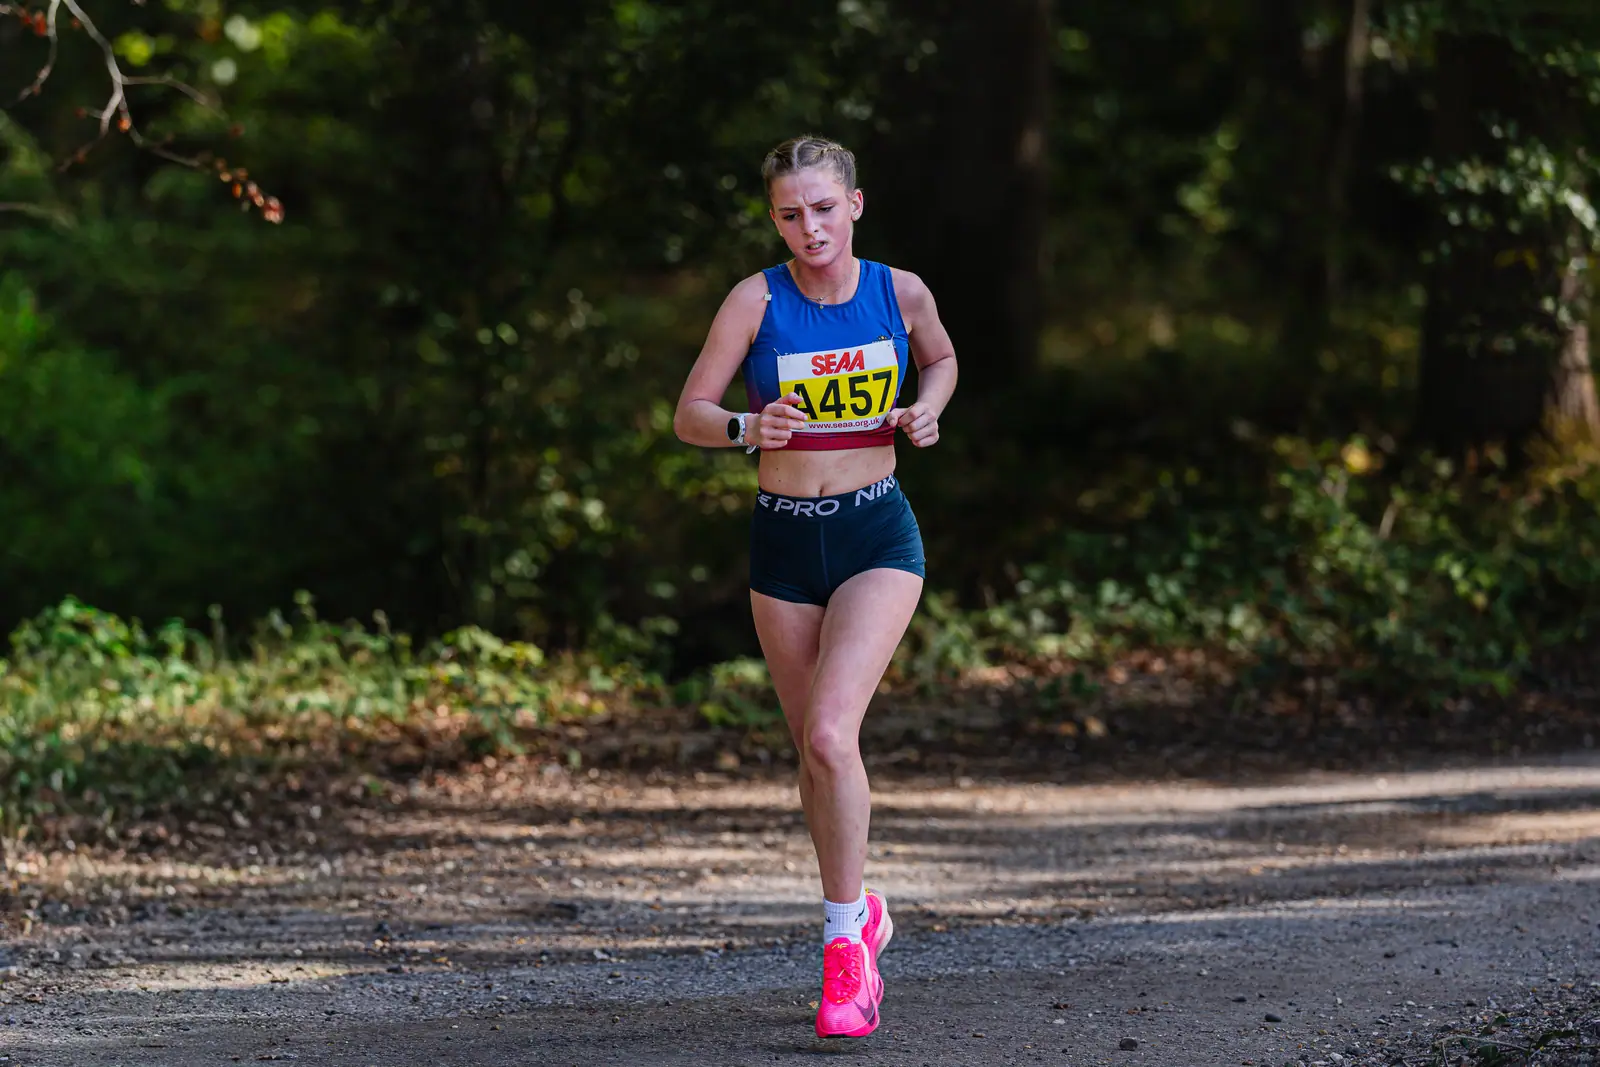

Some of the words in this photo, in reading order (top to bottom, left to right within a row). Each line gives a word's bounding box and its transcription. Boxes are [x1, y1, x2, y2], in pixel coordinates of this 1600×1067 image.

[811, 350, 865, 376] SEAA
[791, 370, 892, 420] A457
[808, 417, 880, 429] www.seaa.org.uk
[774, 498, 839, 517] PRO
